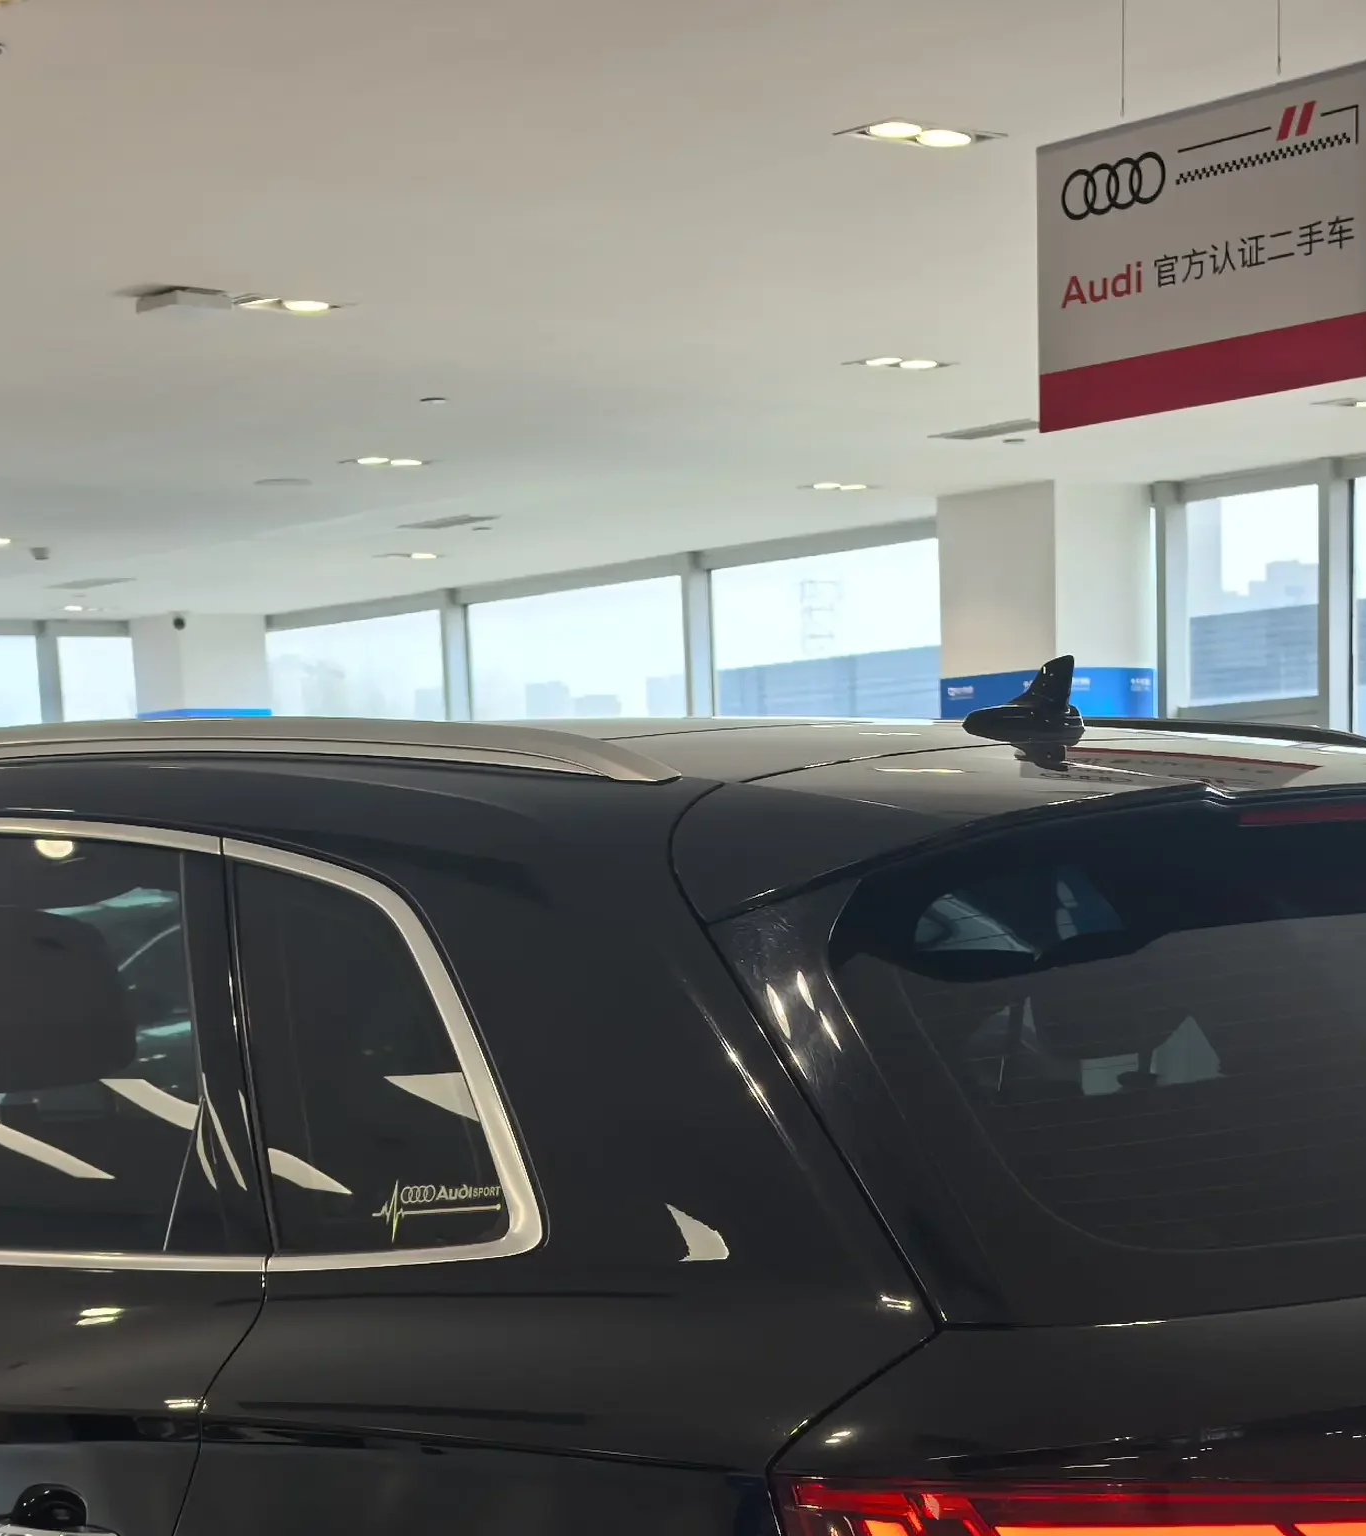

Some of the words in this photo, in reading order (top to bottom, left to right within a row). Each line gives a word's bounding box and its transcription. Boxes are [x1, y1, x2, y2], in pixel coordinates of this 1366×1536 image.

[1060, 260, 1143, 309] Audi
[1153, 215, 1356, 288] 官方认证二手车
